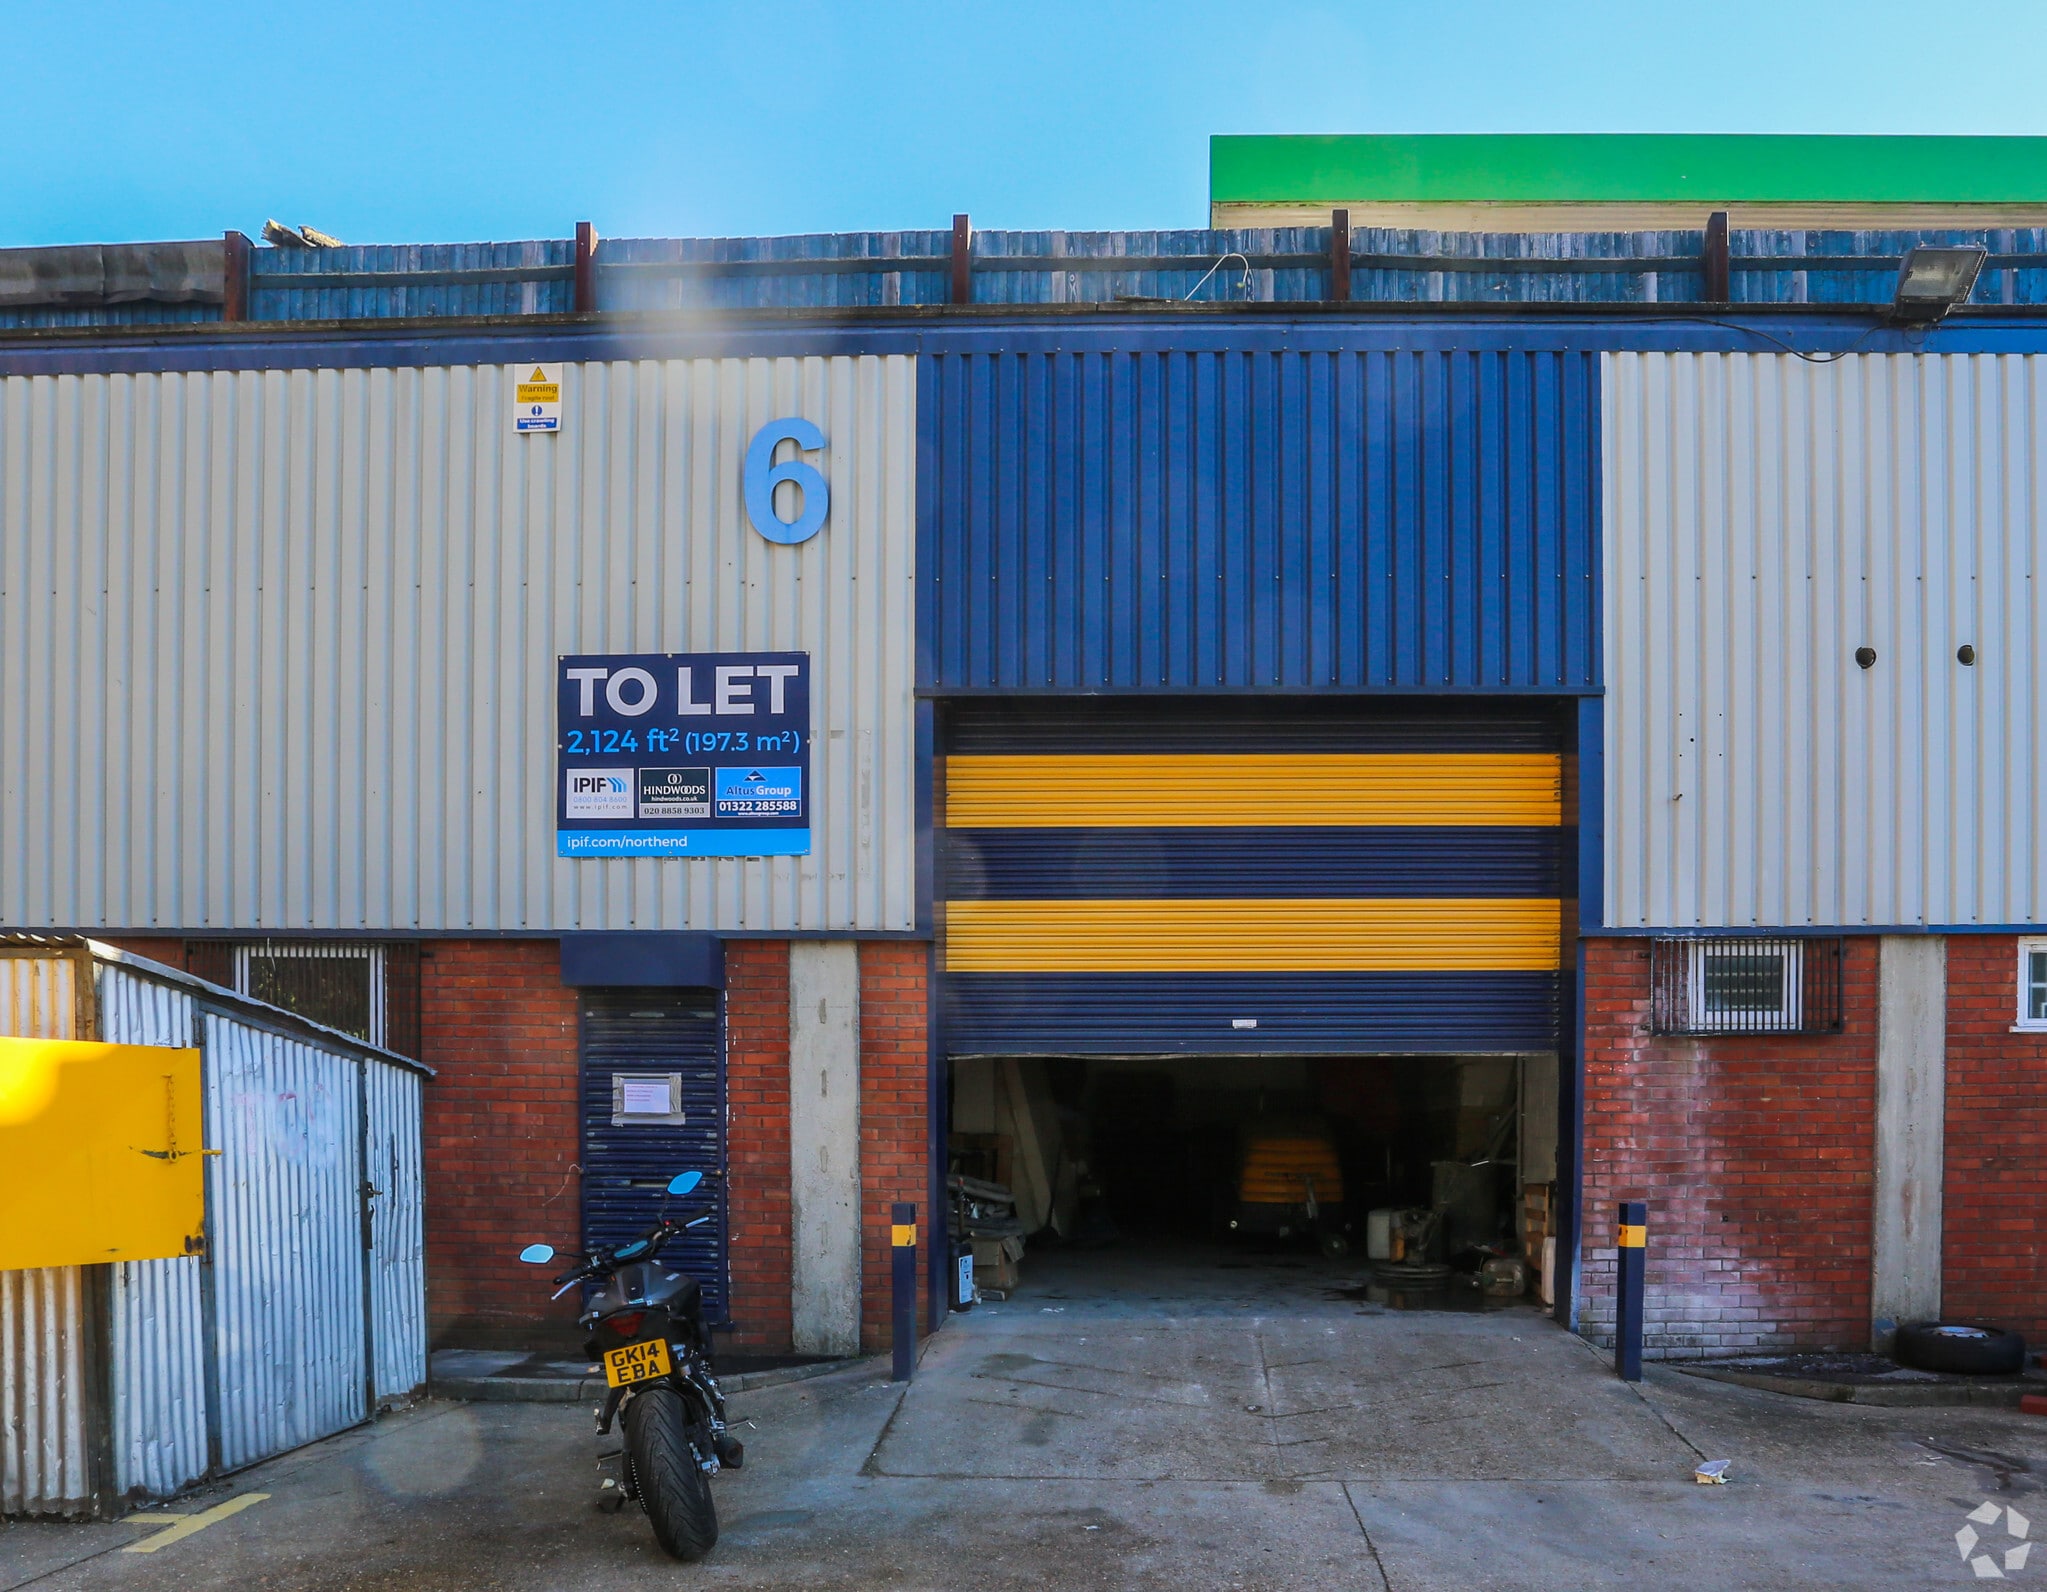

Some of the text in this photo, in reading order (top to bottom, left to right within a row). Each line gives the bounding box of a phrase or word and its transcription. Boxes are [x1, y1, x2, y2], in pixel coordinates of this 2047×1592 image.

[518, 384, 558, 394] Warning
[743, 417, 829, 545] 6
[566, 665, 799, 717] TO LET
[567, 730, 638, 755] 2,124
[685, 731, 749, 755] (197.3
[573, 777, 607, 793] IPIF
[643, 785, 706, 795] HINDWOODS
[644, 807, 660, 815] 020
[661, 807, 682, 815] 8858
[719, 801, 797, 811] 01322 285588
[567, 835, 688, 849] ipif.com/northend
[611, 1342, 660, 1368] GK14
[616, 1360, 660, 1384] EBA
